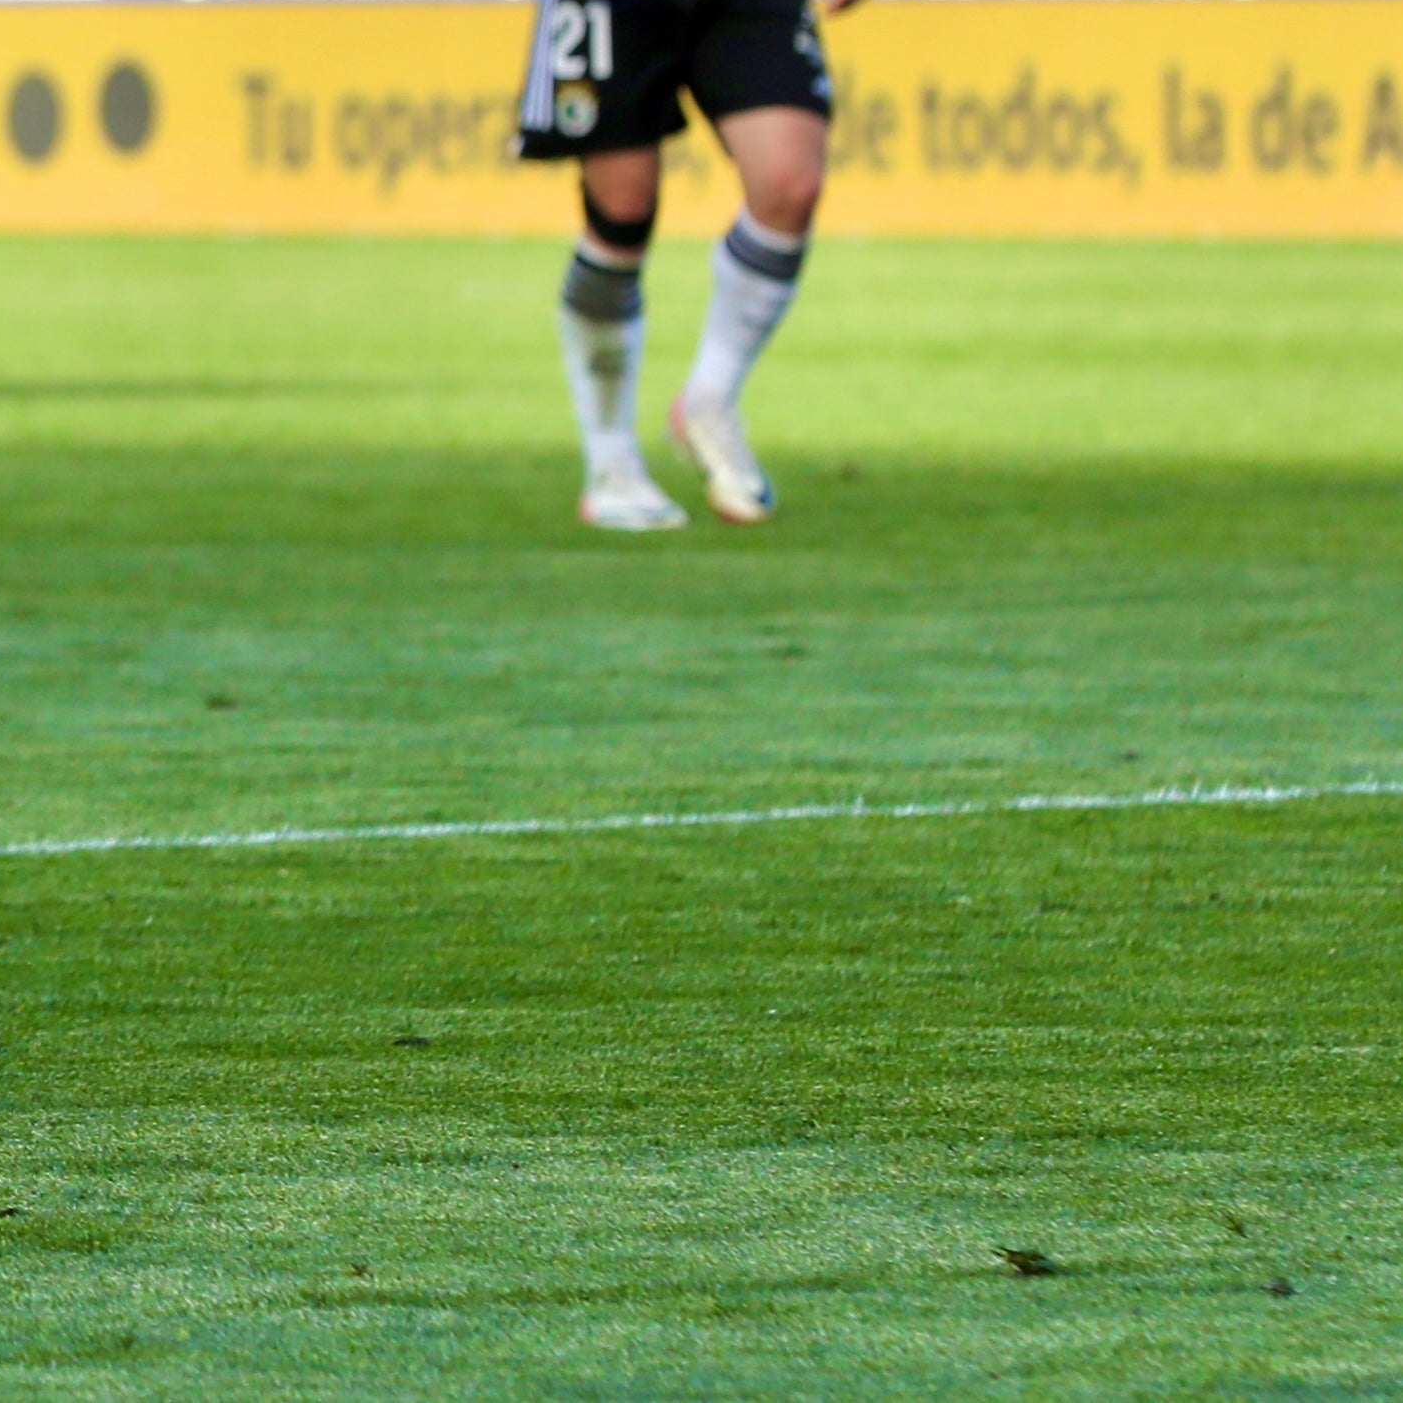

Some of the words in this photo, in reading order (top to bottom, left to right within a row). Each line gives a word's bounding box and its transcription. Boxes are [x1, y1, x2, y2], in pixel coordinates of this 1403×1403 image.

[547, 0, 614, 80] 21
[239, 72, 314, 168] Tu
[918, 61, 1141, 194] todos,
[1160, 58, 1226, 173] la
[1250, 60, 1340, 173] de
